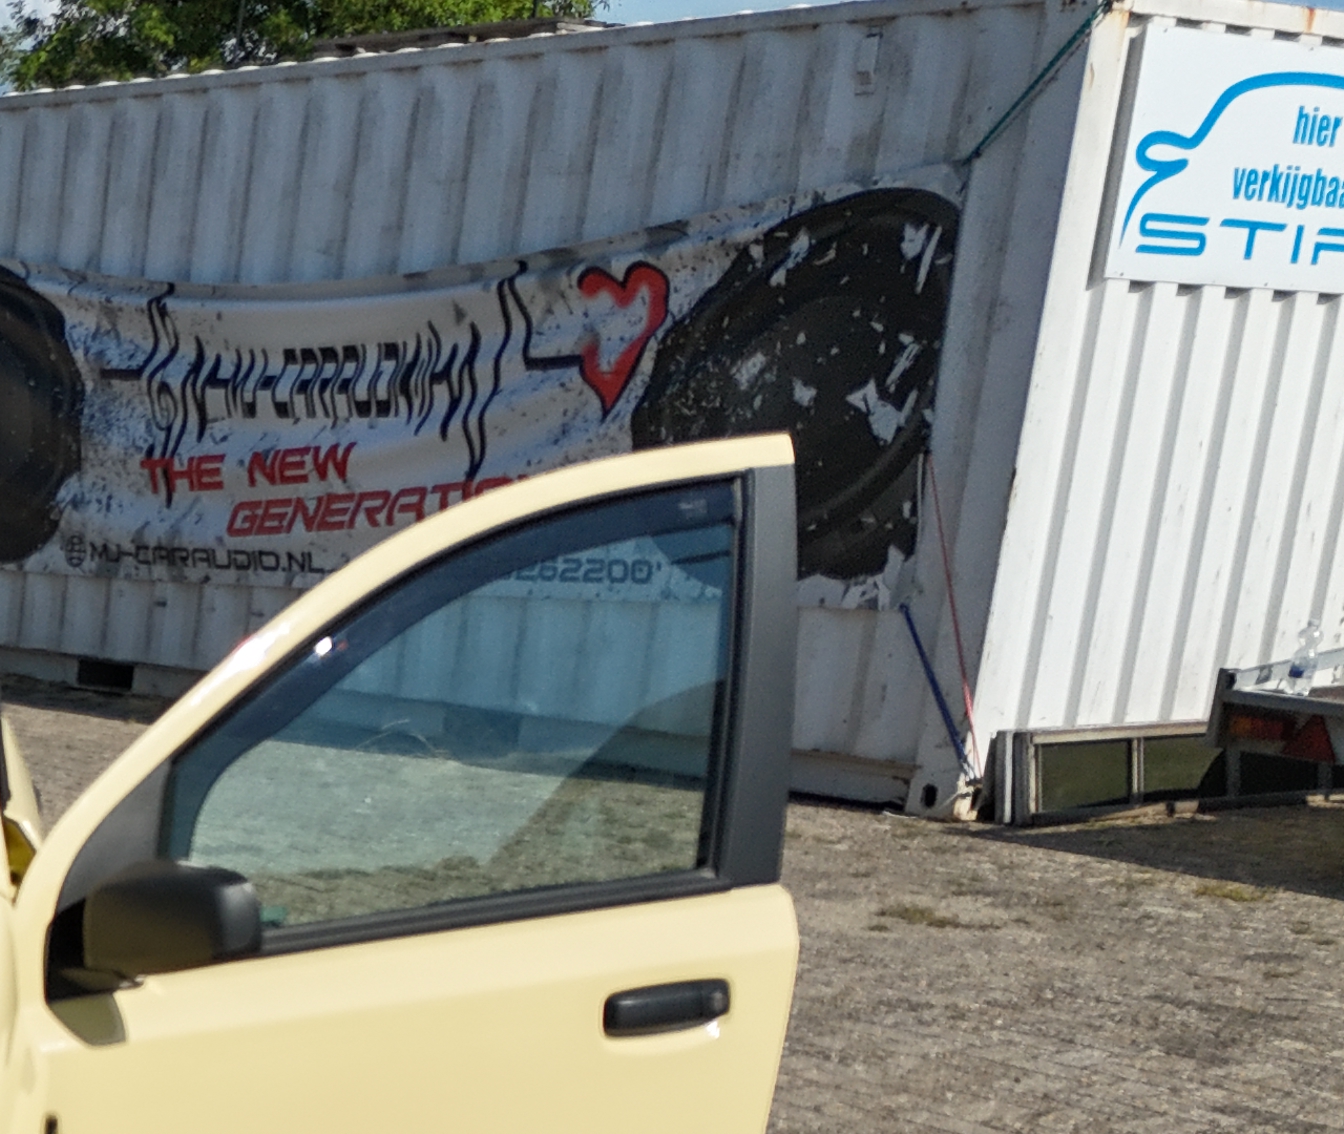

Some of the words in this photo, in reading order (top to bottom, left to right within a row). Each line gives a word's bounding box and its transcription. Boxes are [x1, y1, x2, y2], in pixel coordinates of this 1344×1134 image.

[1293, 105, 1343, 147] hier
[140, 453, 226, 494] THE
[248, 442, 357, 487] NEW
